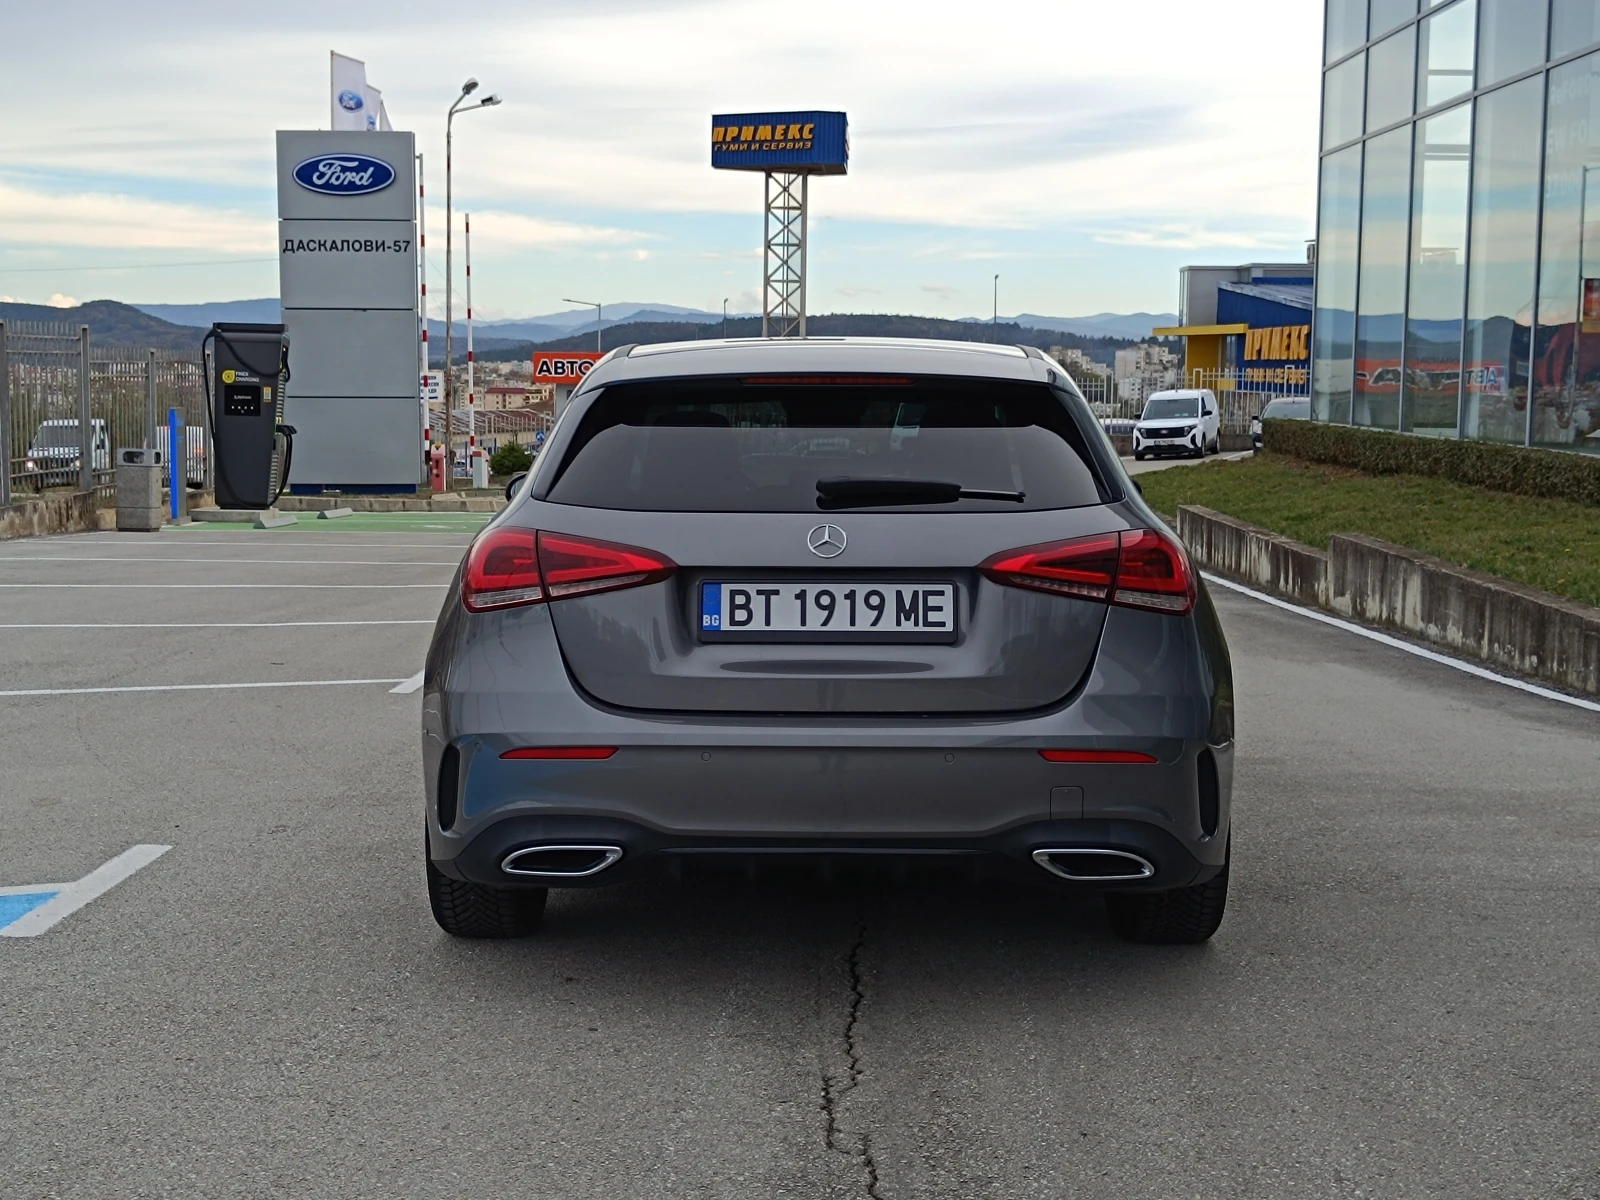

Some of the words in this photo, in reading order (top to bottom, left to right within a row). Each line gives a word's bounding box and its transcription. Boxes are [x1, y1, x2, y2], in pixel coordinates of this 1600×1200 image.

[712, 123, 815, 142] ПРИМЕКС
[714, 144, 747, 152] ГУМИ
[751, 143, 759, 151] И
[762, 141, 812, 151] СЕРВИЗ
[312, 160, 375, 186] Ford
[282, 239, 411, 254] ДАСКАЛОВИ-57
[1244, 324, 1310, 361] ПРИМЕКС
[536, 358, 597, 378] АВТО
[729, 588, 781, 627] BT
[794, 588, 886, 627] 1919
[895, 589, 947, 628] ME
[703, 614, 720, 626] BG
